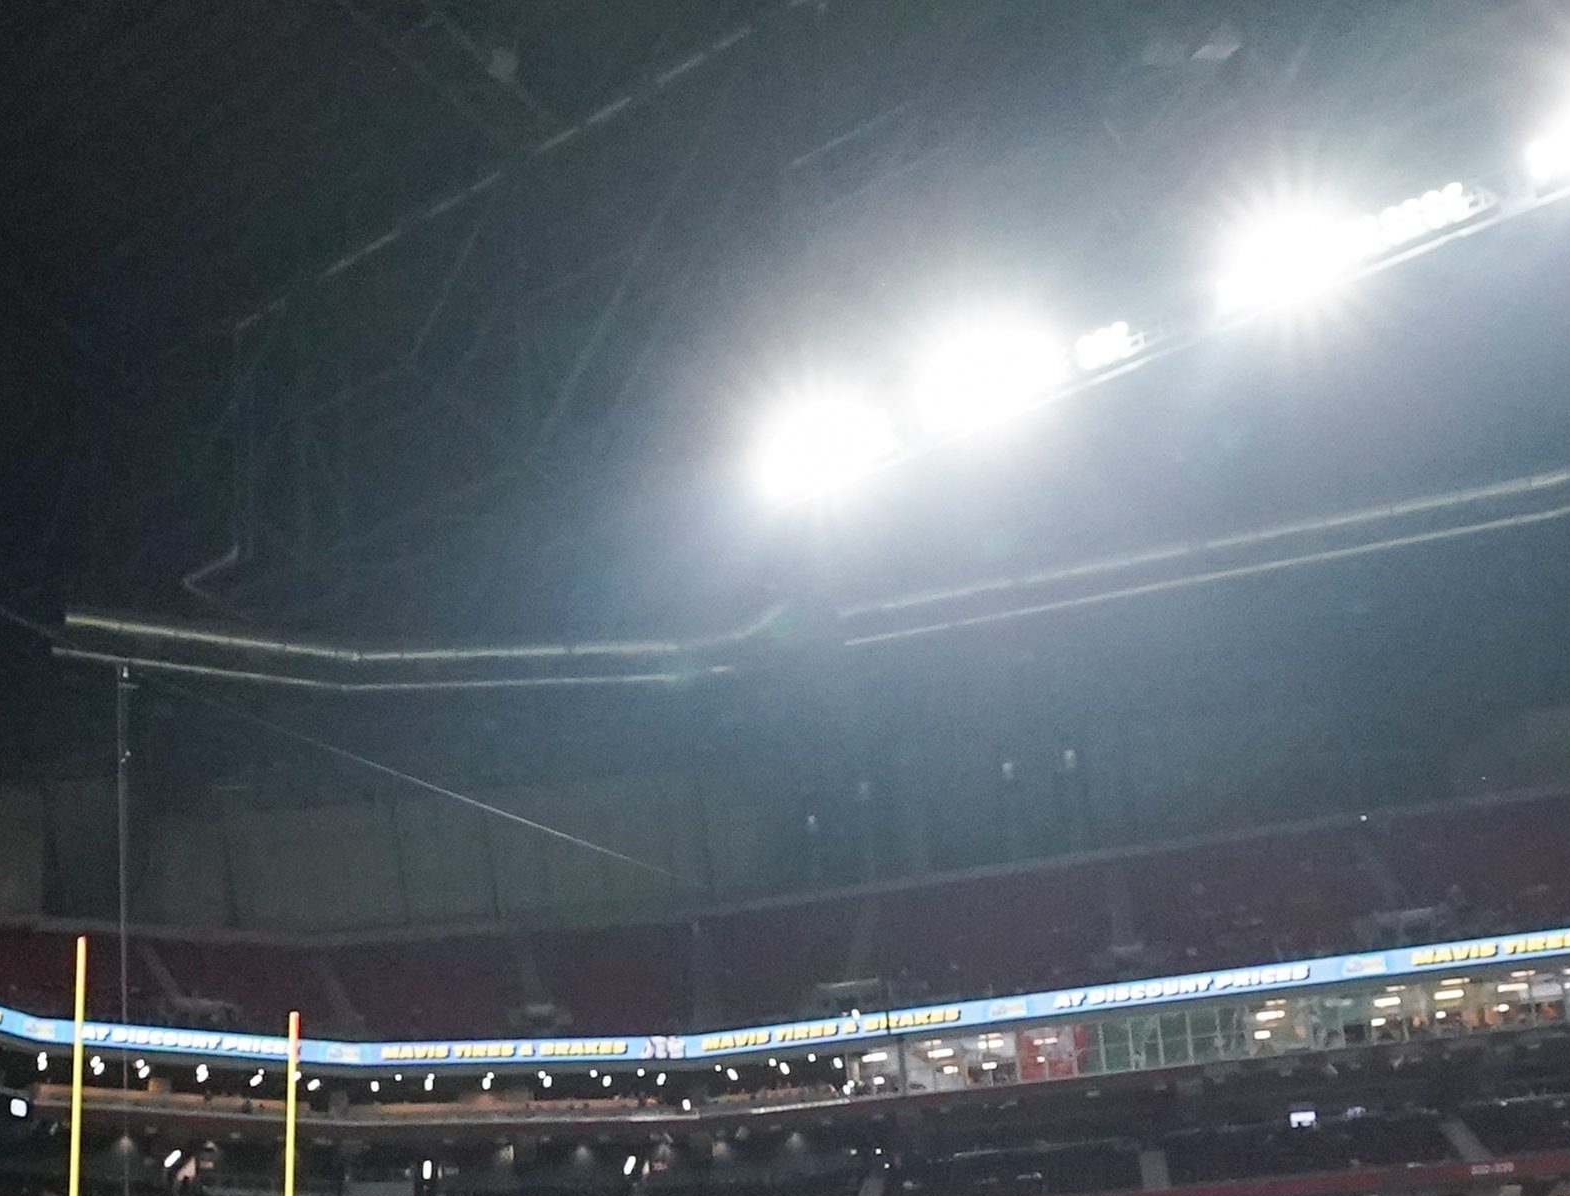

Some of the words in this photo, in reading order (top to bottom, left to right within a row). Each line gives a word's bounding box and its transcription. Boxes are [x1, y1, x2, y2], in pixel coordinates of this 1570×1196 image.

[1411, 943, 1498, 966] MAVIS
[1053, 992, 1088, 1009] AT
[1092, 976, 1214, 1006] DISCOUNT
[1212, 964, 1311, 990] PRICES
[81, 1025, 110, 1041] AT
[111, 1027, 222, 1049] DISCOUNT
[702, 1031, 771, 1051] MAVIS
[776, 1023, 839, 1042] TIRES
[864, 1008, 961, 1032] BRAKES
[382, 1044, 449, 1059] MAVIS
[453, 1043, 516, 1058] TIRES
[539, 1040, 628, 1056] BRAKES
